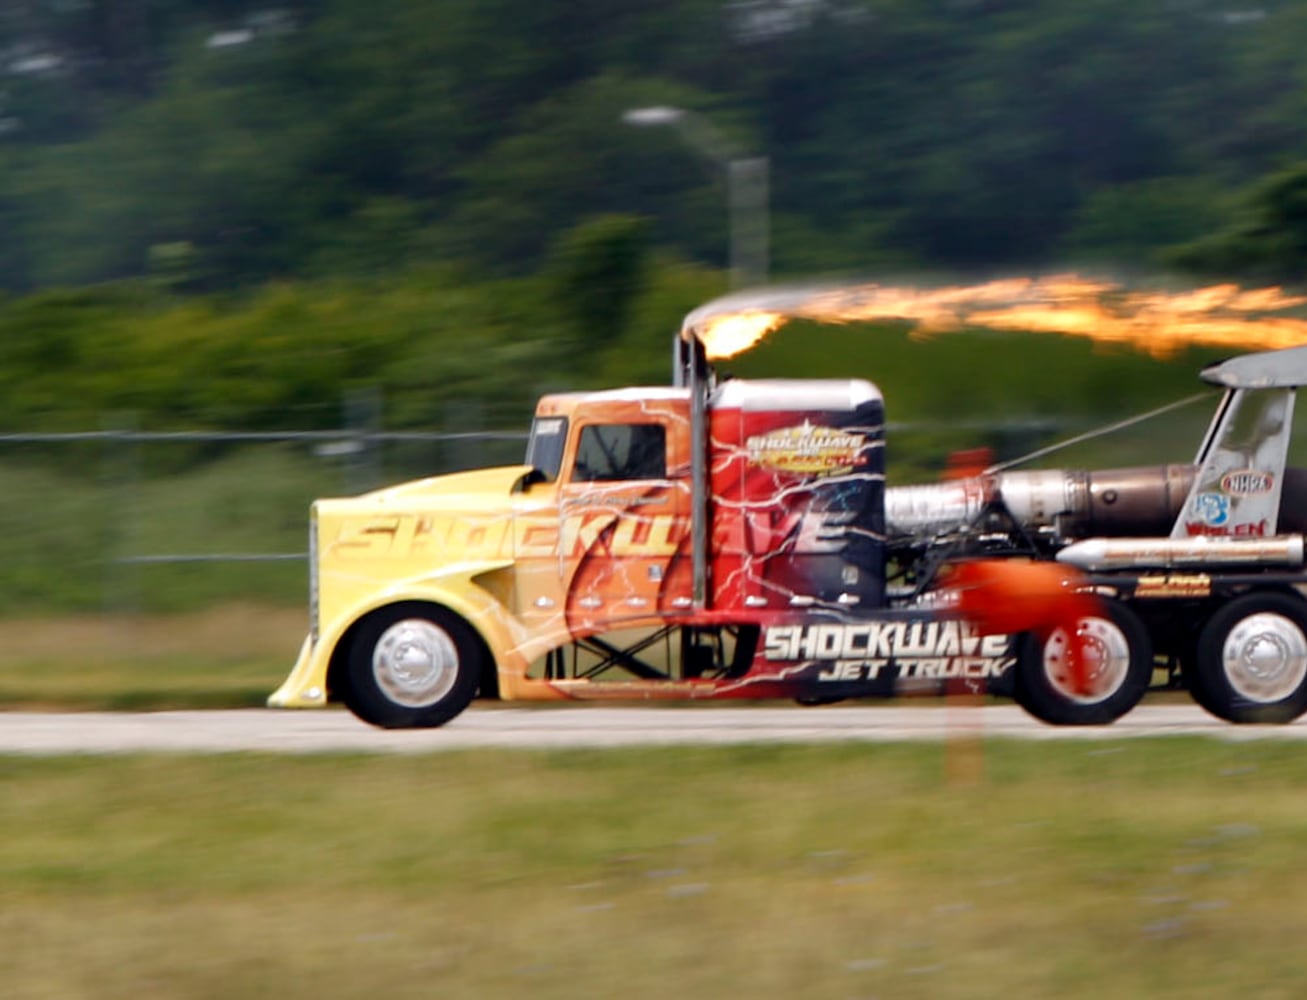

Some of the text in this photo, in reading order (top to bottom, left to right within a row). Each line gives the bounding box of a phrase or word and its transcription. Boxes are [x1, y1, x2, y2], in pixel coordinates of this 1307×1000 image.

[747, 434, 866, 450] SHOCKWAVE
[1229, 474, 1269, 495] NHRA
[333, 514, 860, 558] SHOCKWAVE
[765, 619, 1010, 660] SHOCKWAVE
[818, 657, 1018, 681] JET TRUCK
